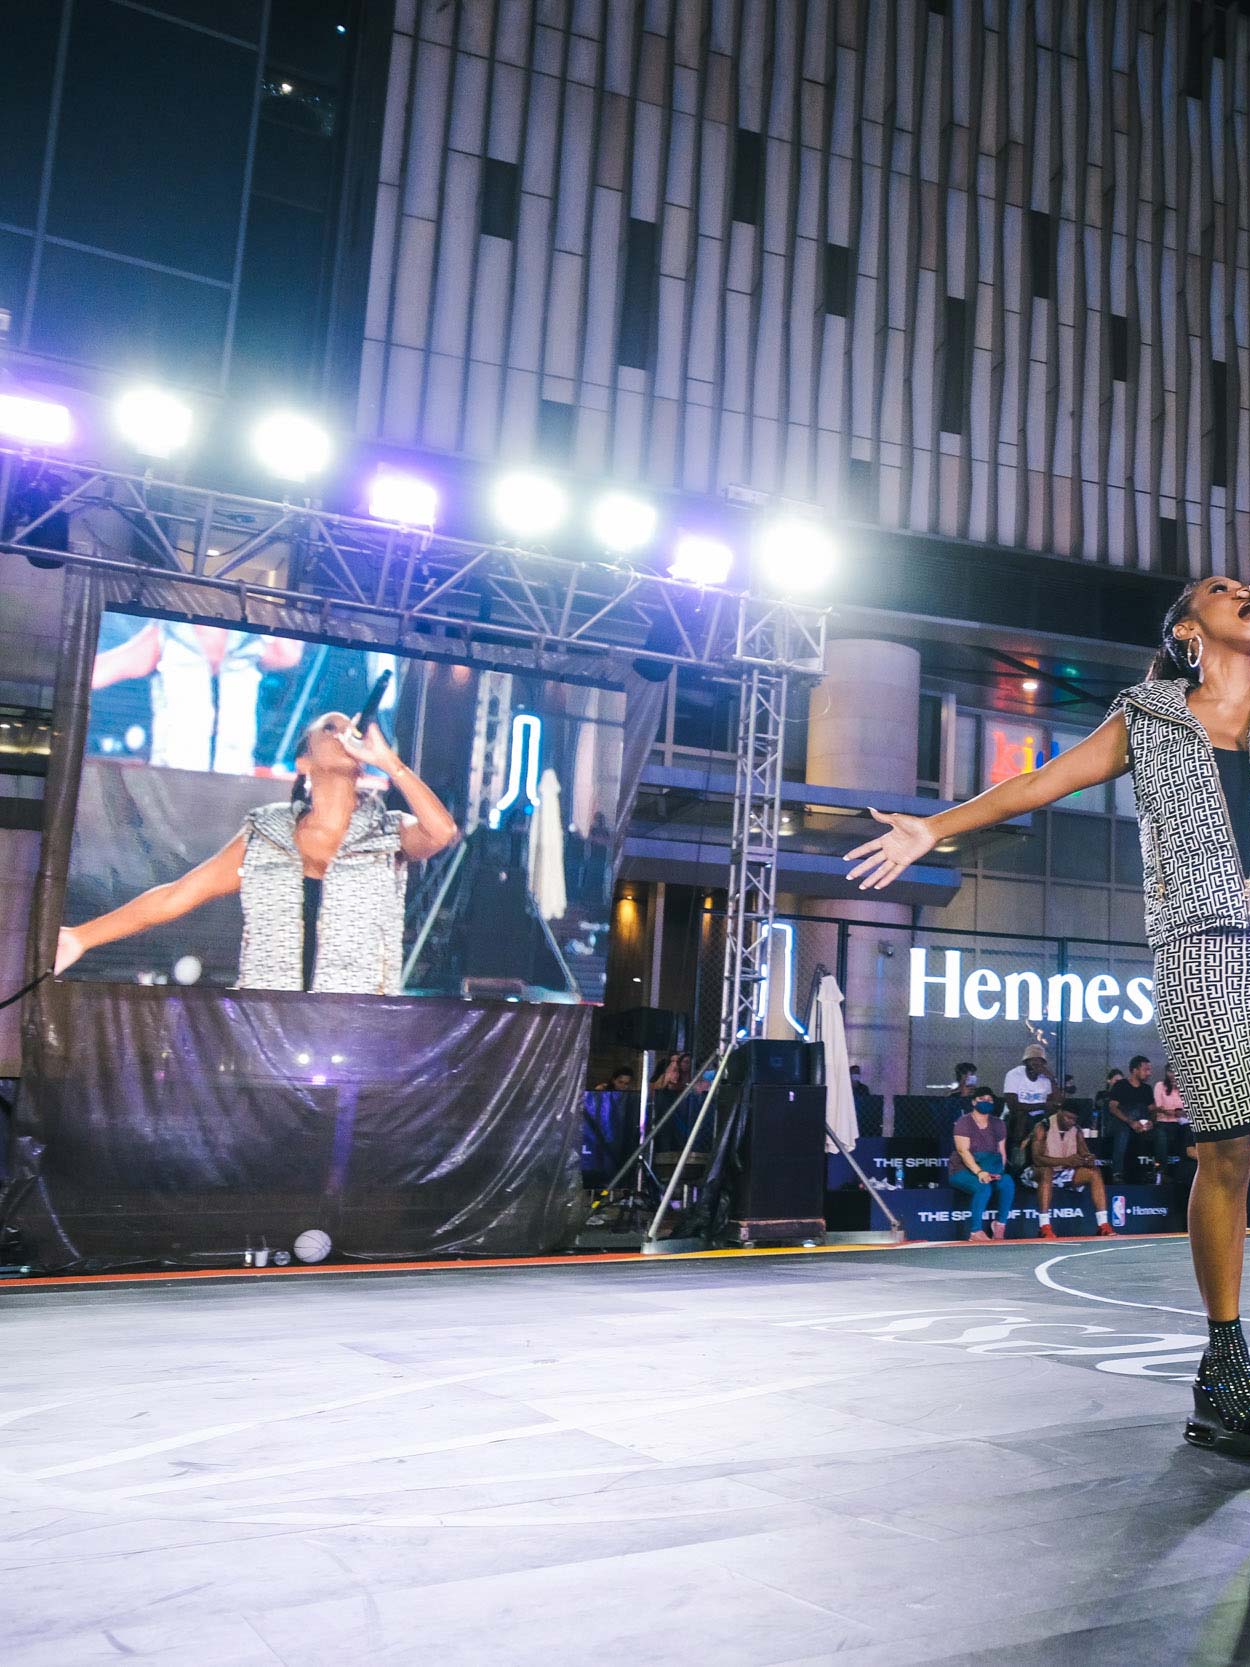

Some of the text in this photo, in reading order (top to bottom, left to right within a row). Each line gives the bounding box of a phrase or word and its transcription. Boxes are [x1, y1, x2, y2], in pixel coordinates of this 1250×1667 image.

[909, 947, 1154, 1025] Hennes
[873, 1157, 950, 1168] THE SPIRIT
[918, 1211, 949, 1222] THE
[951, 1210, 998, 1221] SPIT
[1053, 1208, 1084, 1218] NBA
[1132, 1205, 1168, 1217] Hennessy
